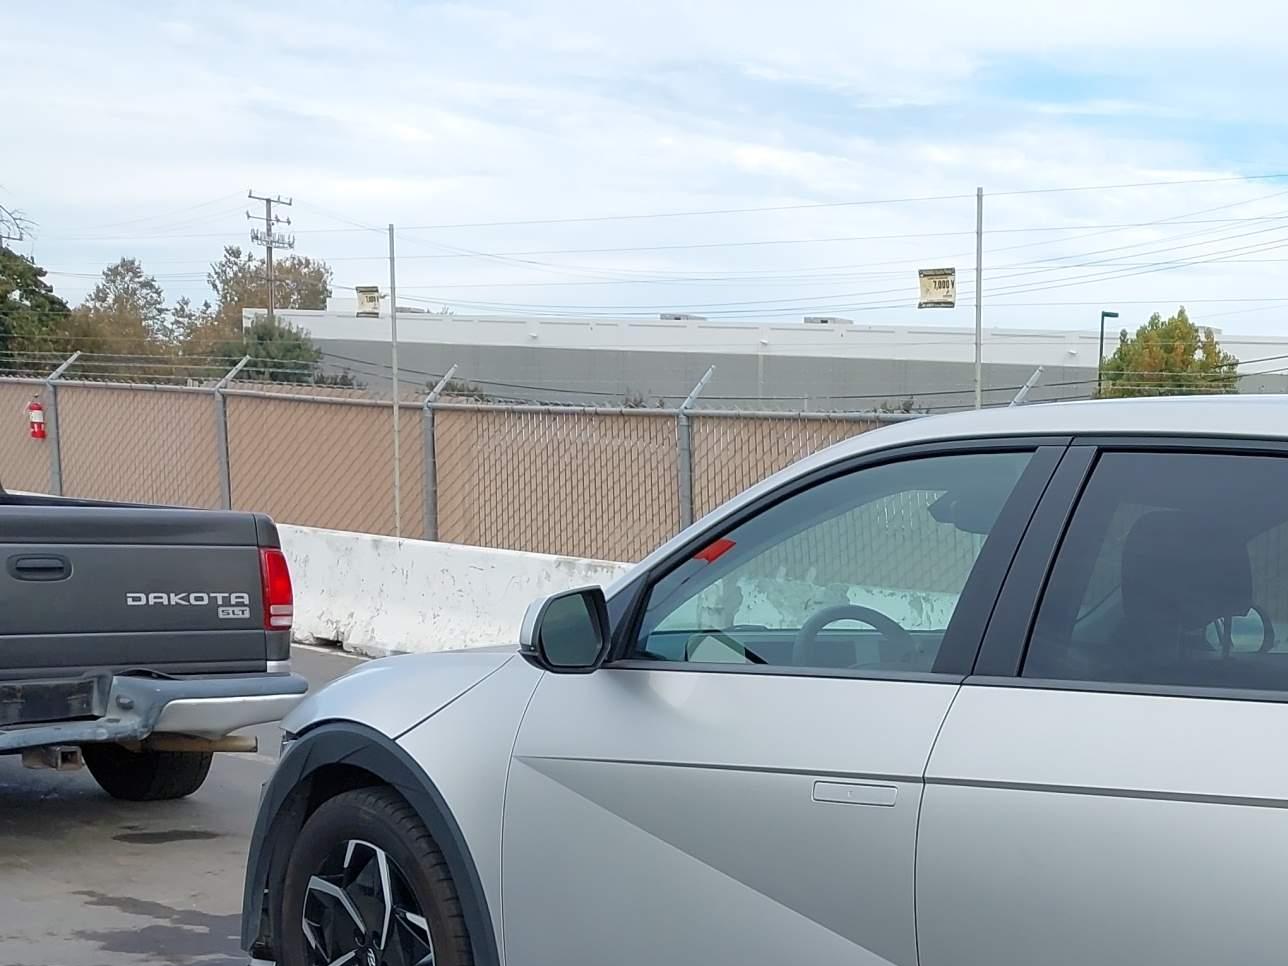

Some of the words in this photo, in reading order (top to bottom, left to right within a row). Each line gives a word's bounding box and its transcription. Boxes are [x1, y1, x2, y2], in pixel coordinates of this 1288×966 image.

[932, 279, 950, 291] 7,000
[126, 592, 250, 606] DAKOTA
[220, 608, 248, 617] SLT
